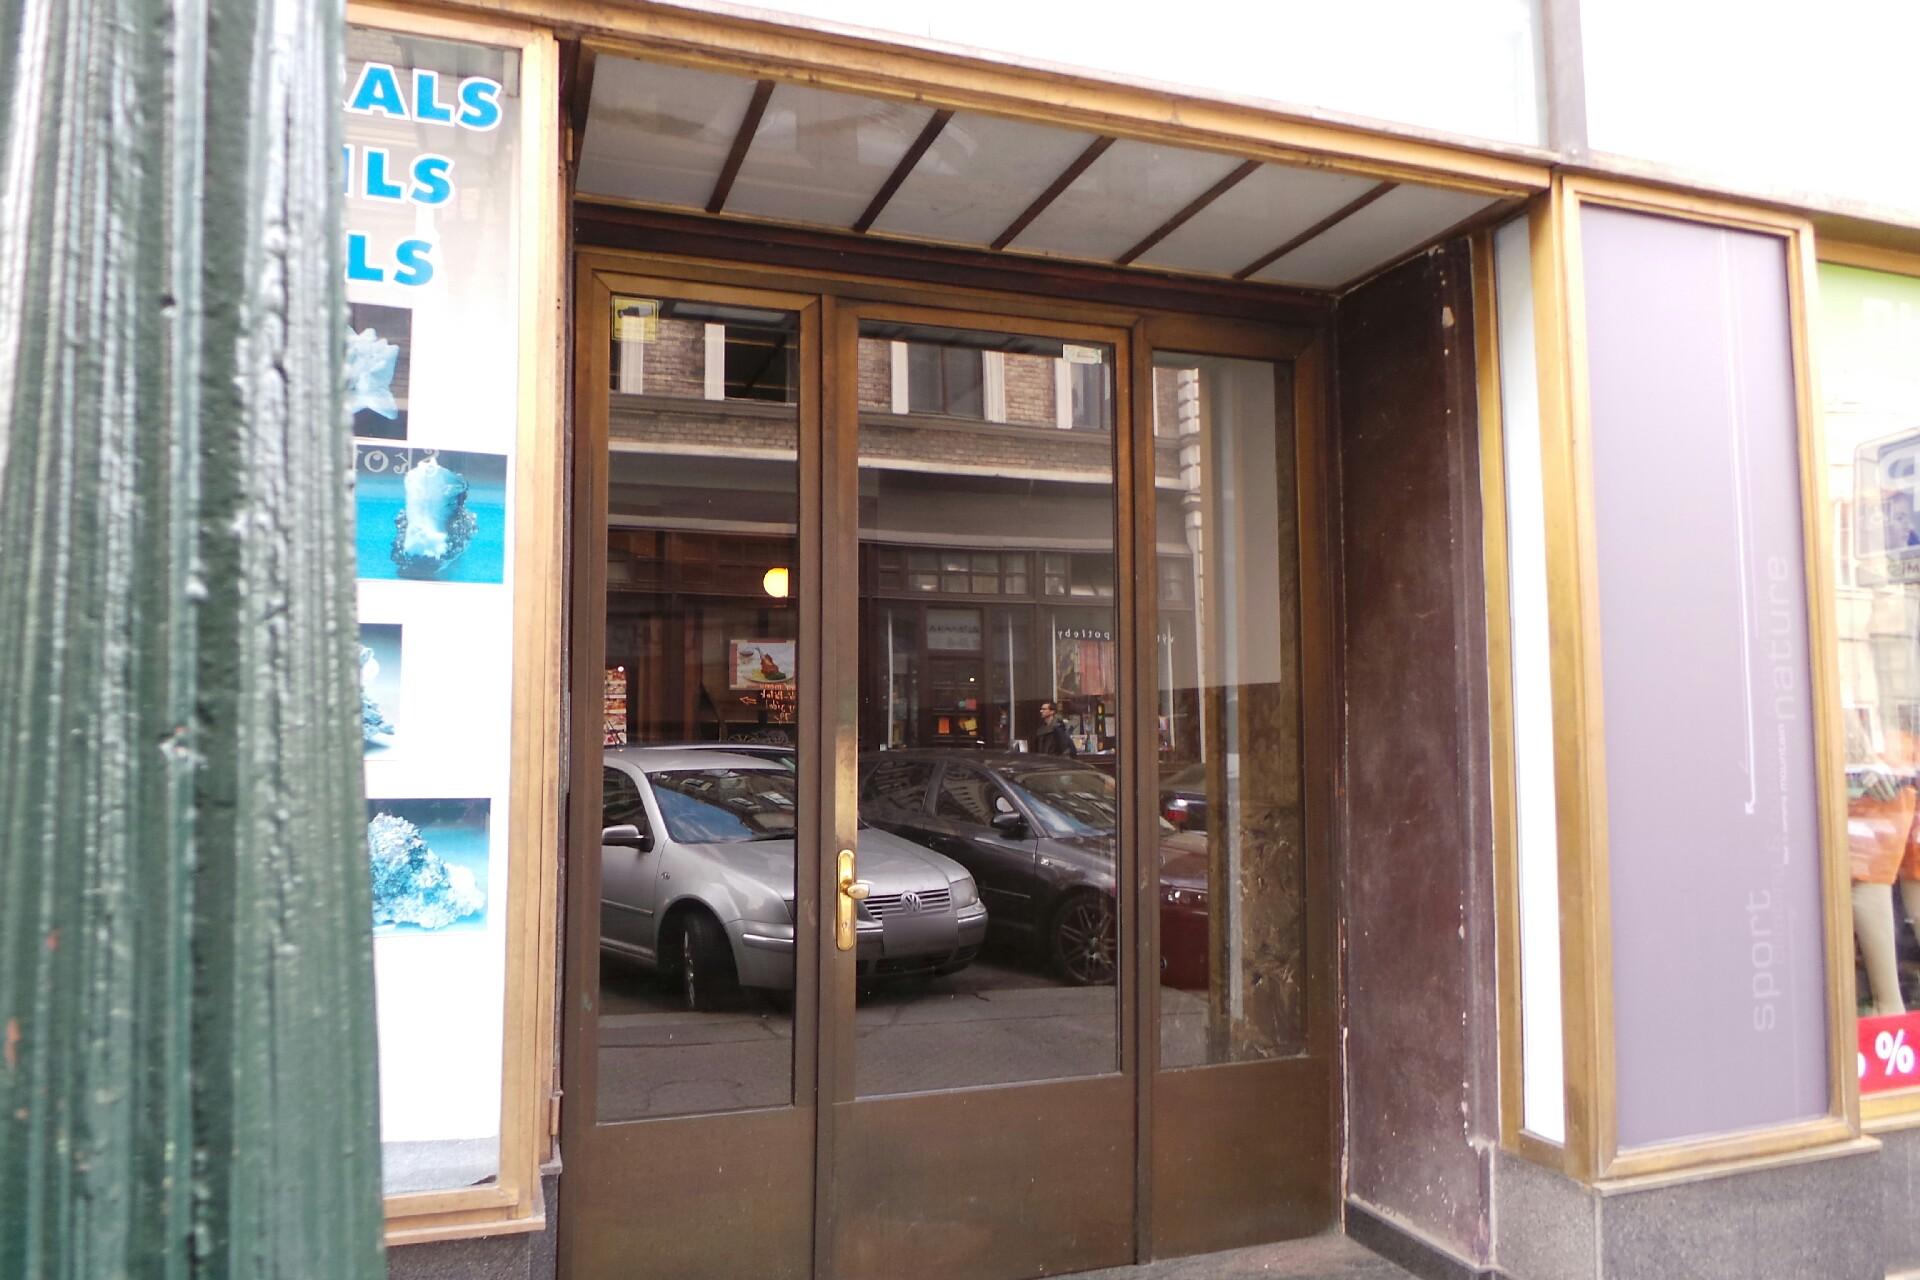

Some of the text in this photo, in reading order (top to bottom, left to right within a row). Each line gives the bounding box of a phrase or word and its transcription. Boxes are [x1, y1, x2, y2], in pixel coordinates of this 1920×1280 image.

[347, 62, 502, 131] ALS
[346, 232, 436, 288] LS
[1767, 555, 1797, 721] nature
[1745, 888, 1782, 1032] sport
